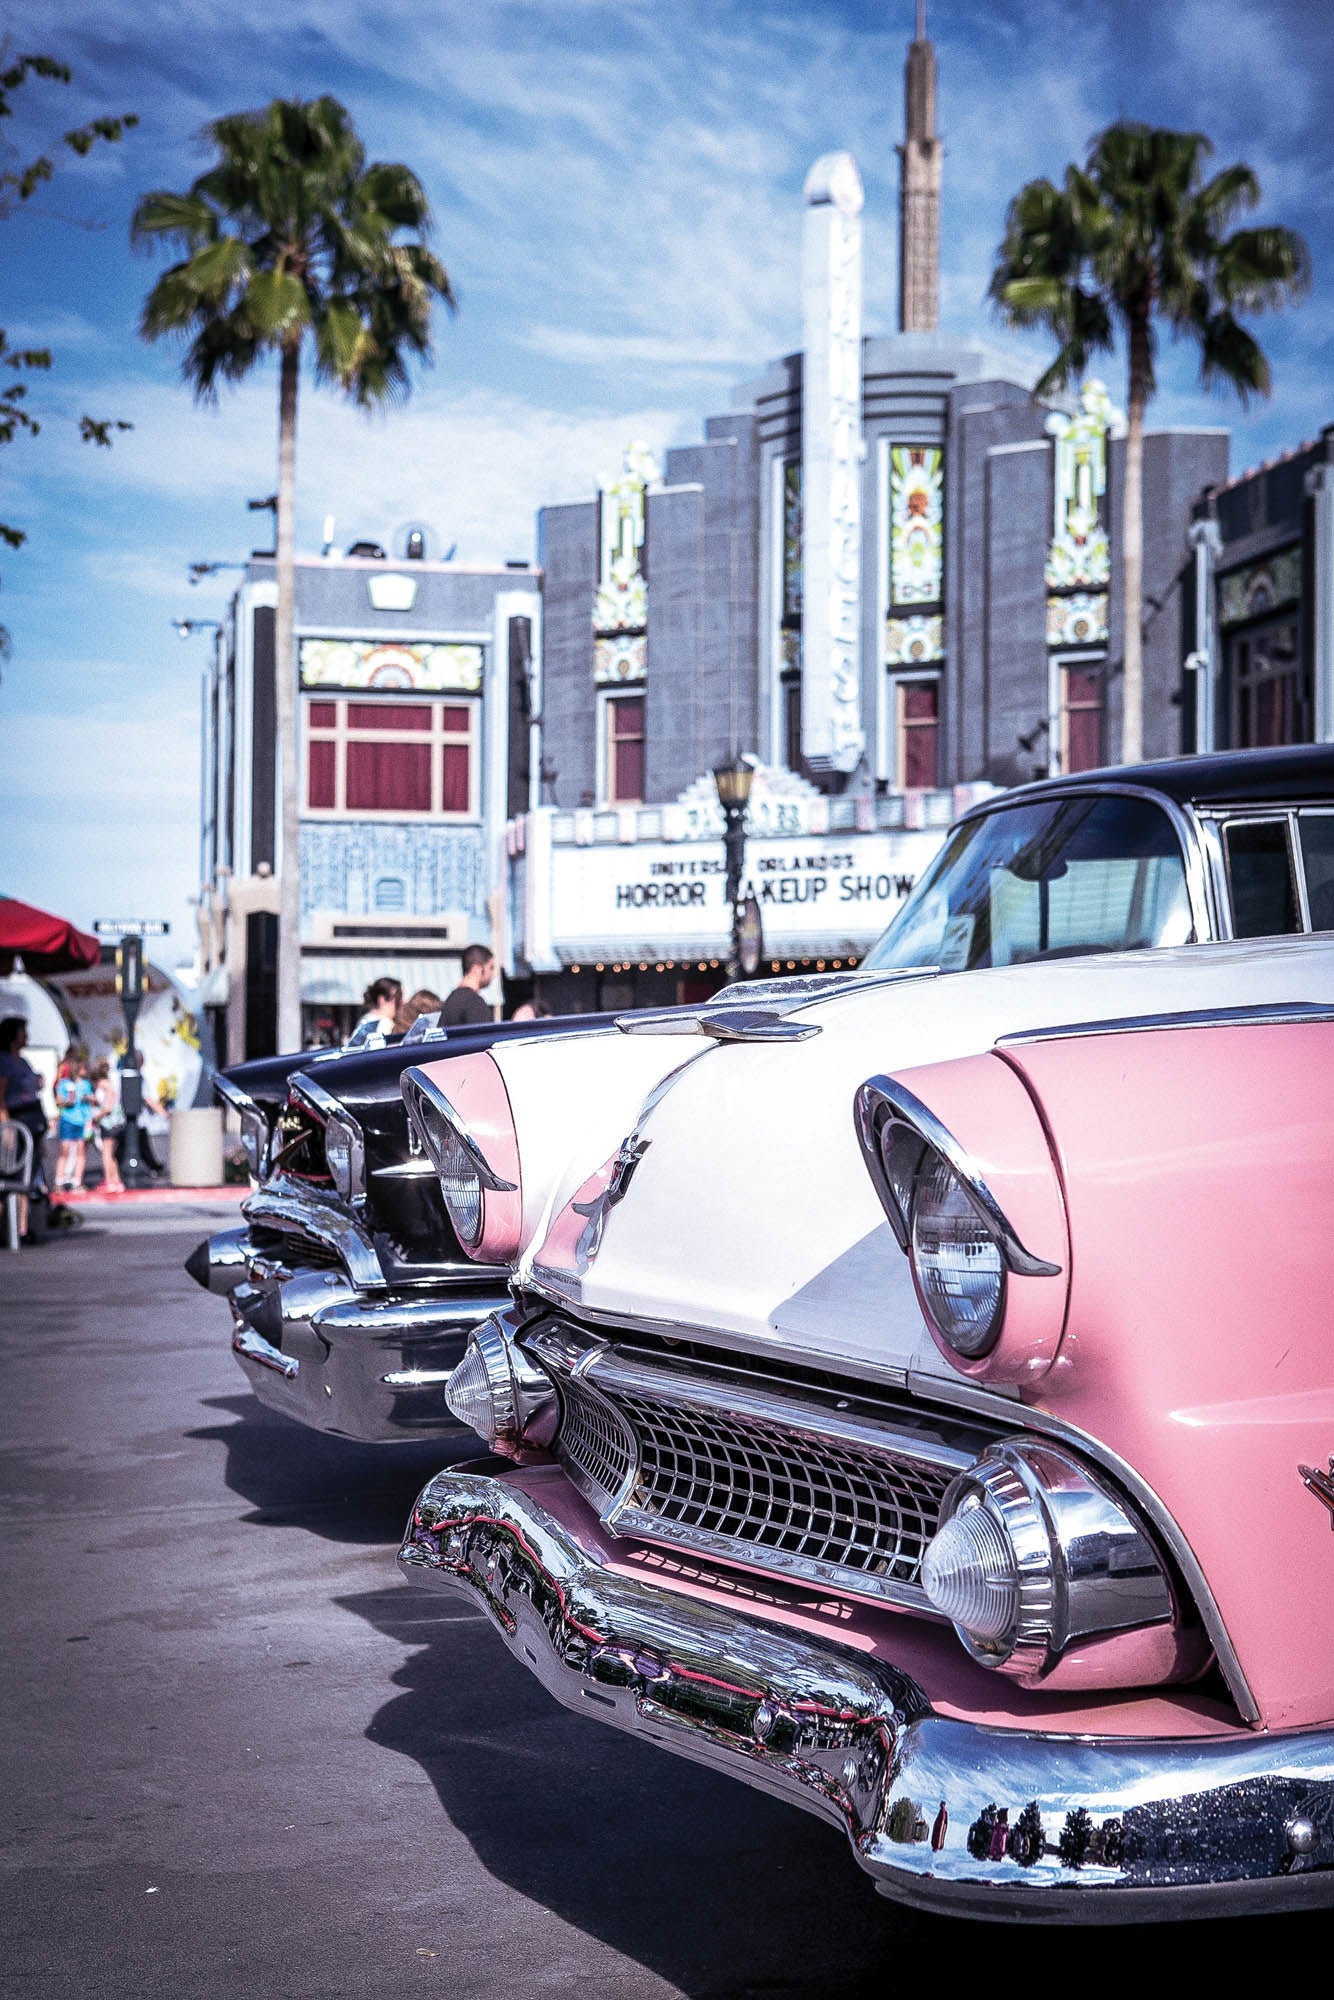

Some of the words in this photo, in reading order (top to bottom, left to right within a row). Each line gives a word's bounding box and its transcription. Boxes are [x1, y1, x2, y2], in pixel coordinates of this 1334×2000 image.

[650, 860, 734, 875] UNIVERS
[616, 881, 706, 908] HORROR
[725, 876, 827, 904] AKEUP
[839, 873, 915, 901] SHOW
